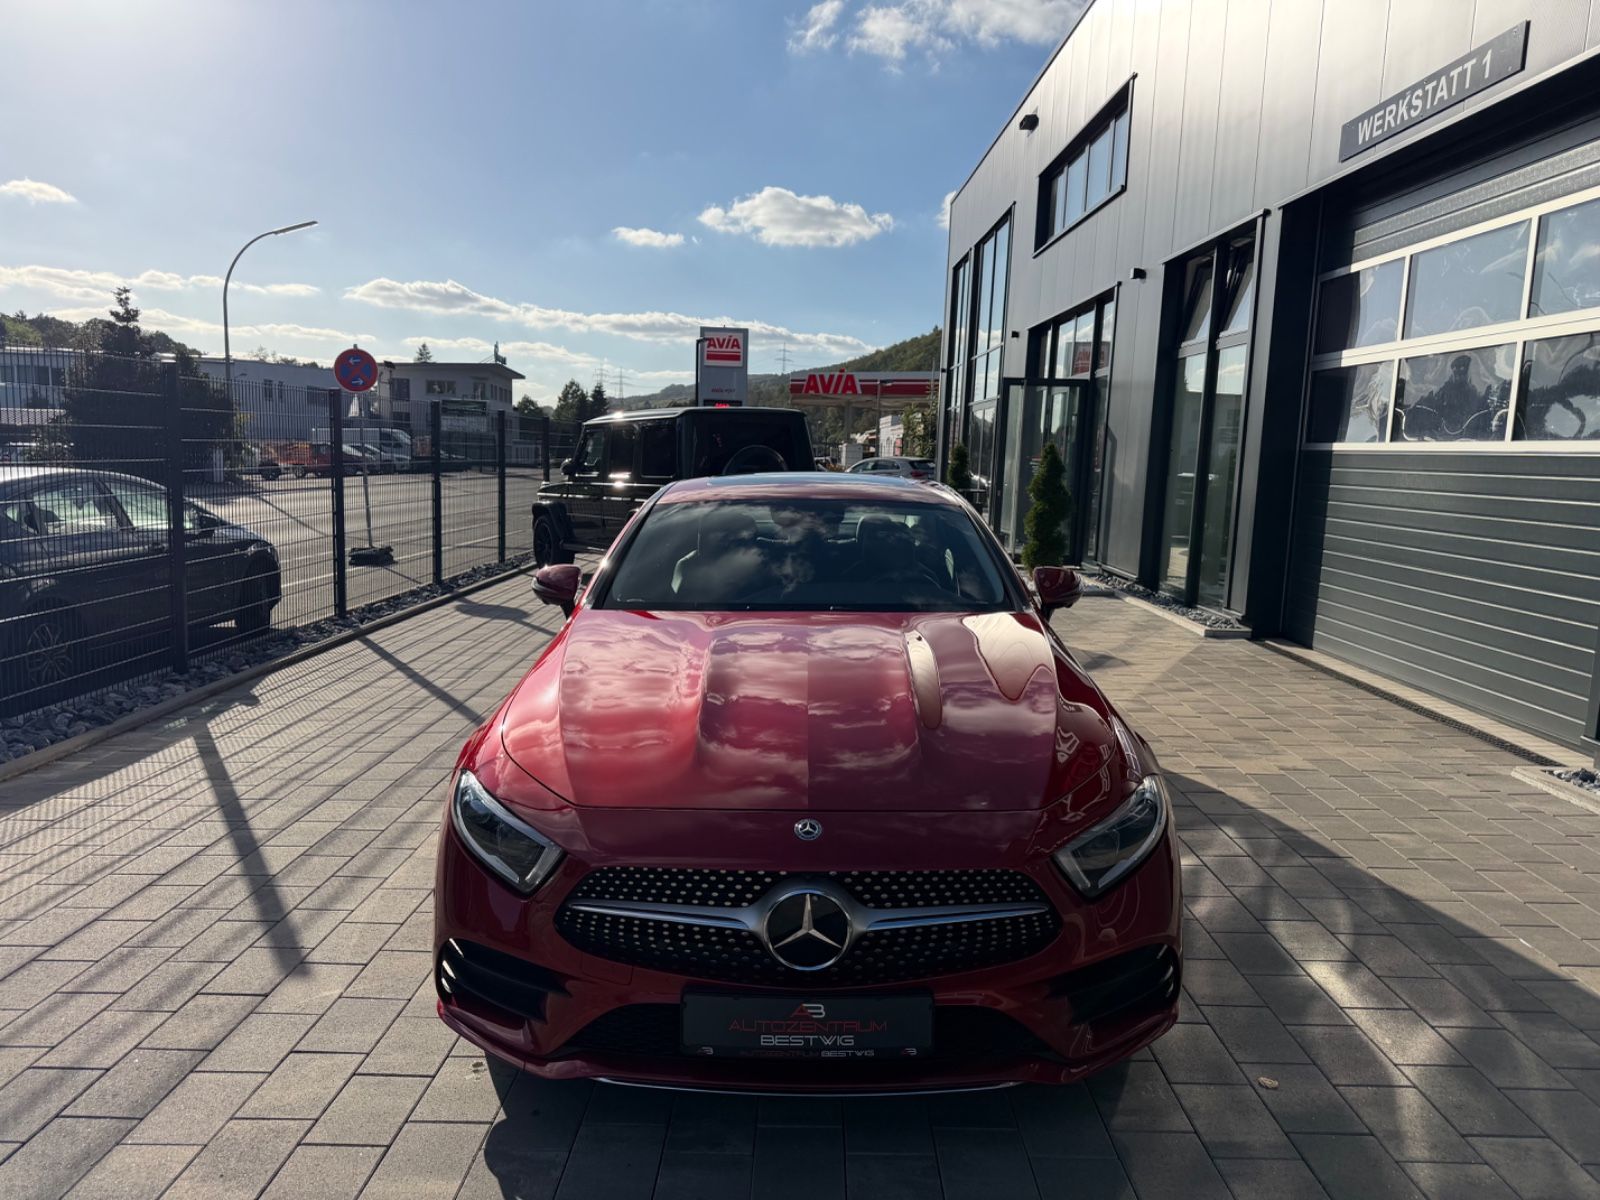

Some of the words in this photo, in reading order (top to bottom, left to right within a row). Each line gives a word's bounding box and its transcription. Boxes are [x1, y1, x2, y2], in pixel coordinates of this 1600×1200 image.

[1358, 58, 1476, 145] WERKSTATT
[1482, 49, 1492, 78] 1
[707, 335, 740, 349] AVIA
[803, 368, 859, 394] AVIA
[728, 1019, 887, 1032] AUTOZENTRUM
[760, 1034, 854, 1046] BESTWIG
